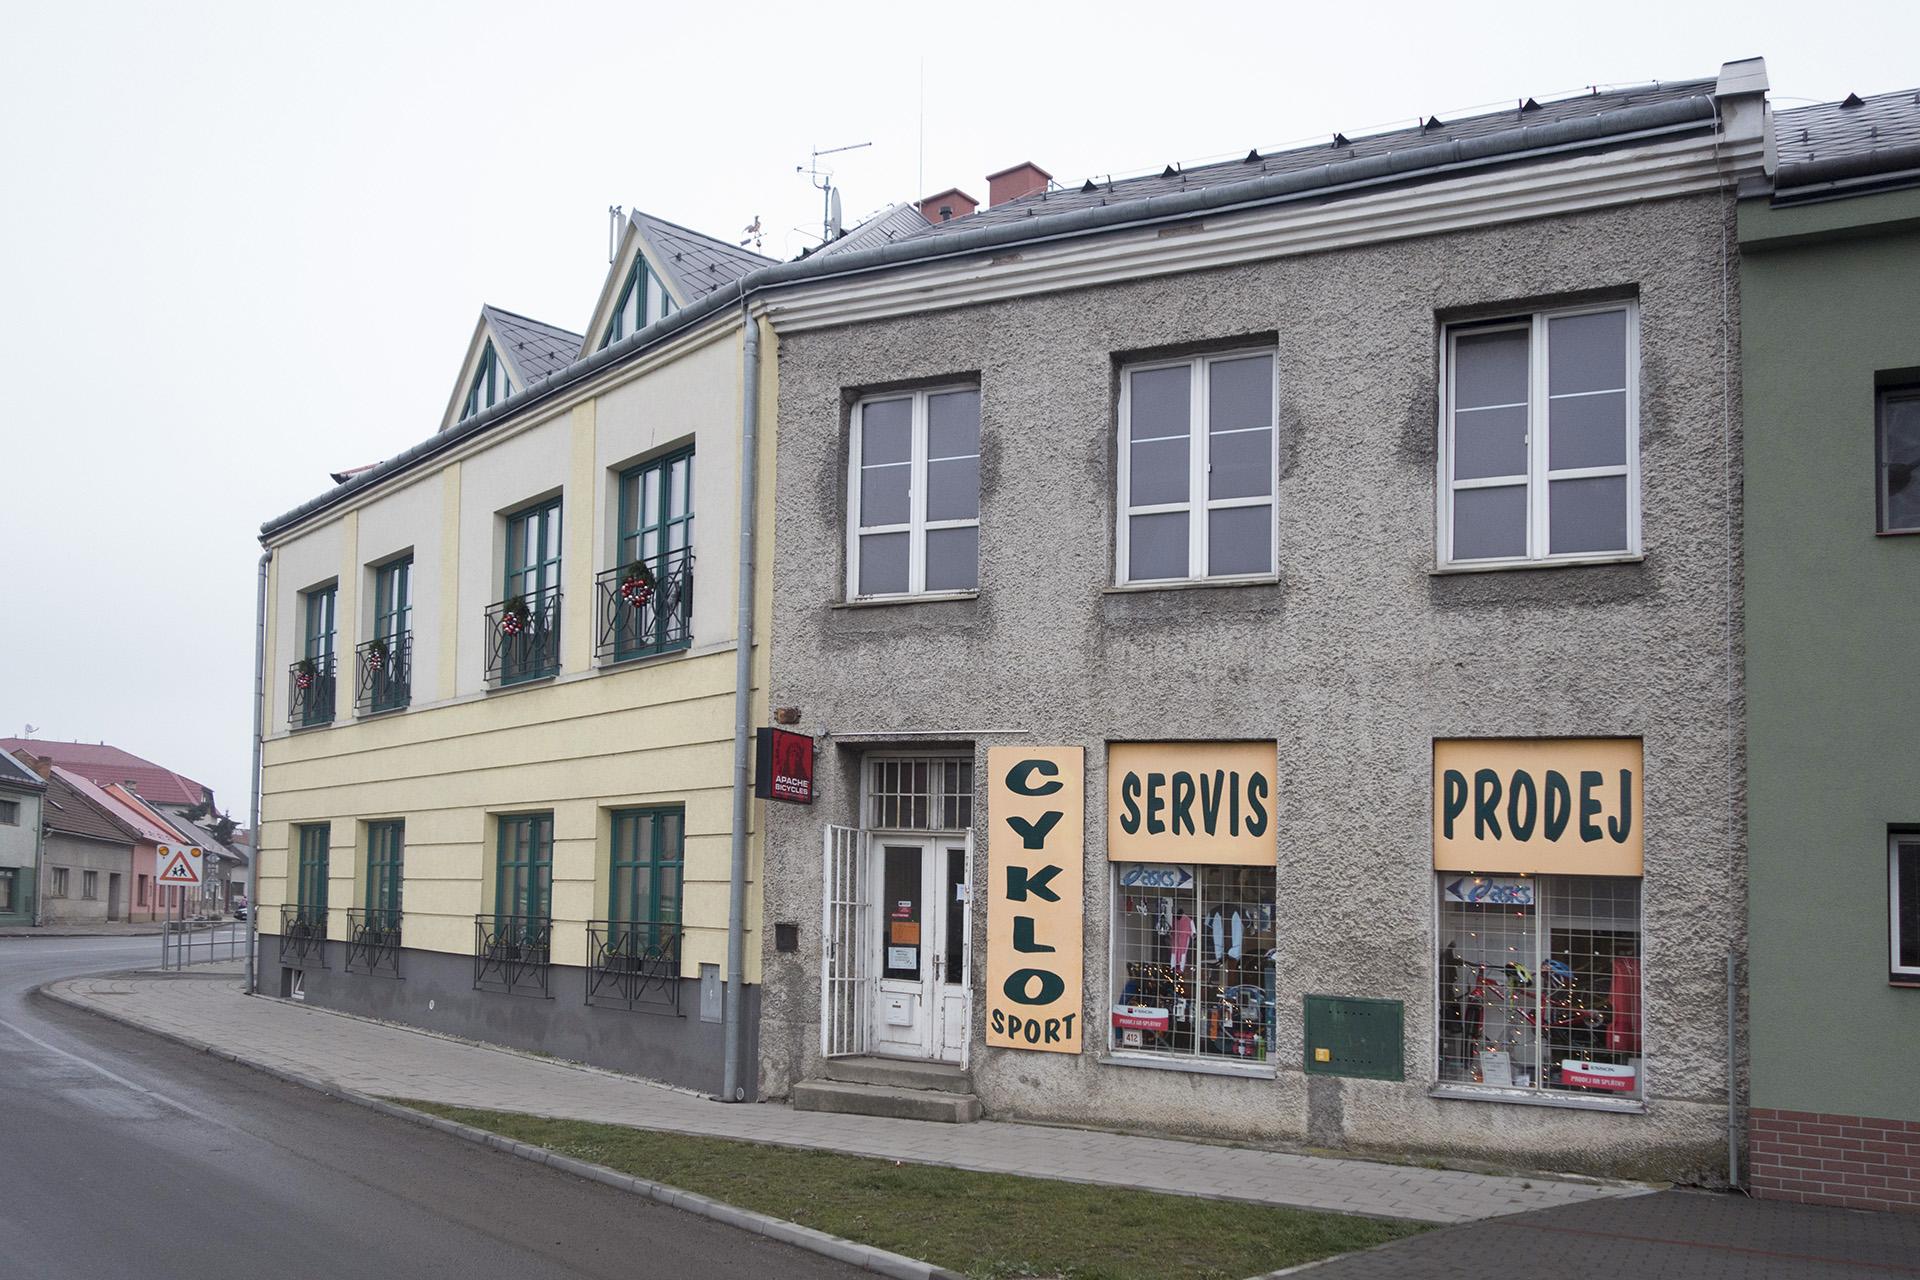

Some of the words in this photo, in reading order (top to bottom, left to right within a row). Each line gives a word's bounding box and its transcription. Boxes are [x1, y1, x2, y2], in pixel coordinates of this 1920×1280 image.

[775, 775, 808, 788] APACHE
[775, 783, 808, 795] BICYCLES
[1120, 769, 1269, 838] SERVIS
[1443, 768, 1632, 844] PRODEJ
[1003, 759, 1065, 1006] CYKLO
[990, 1008, 1076, 1044] SPORT
[1126, 1033, 1138, 1042] 412
